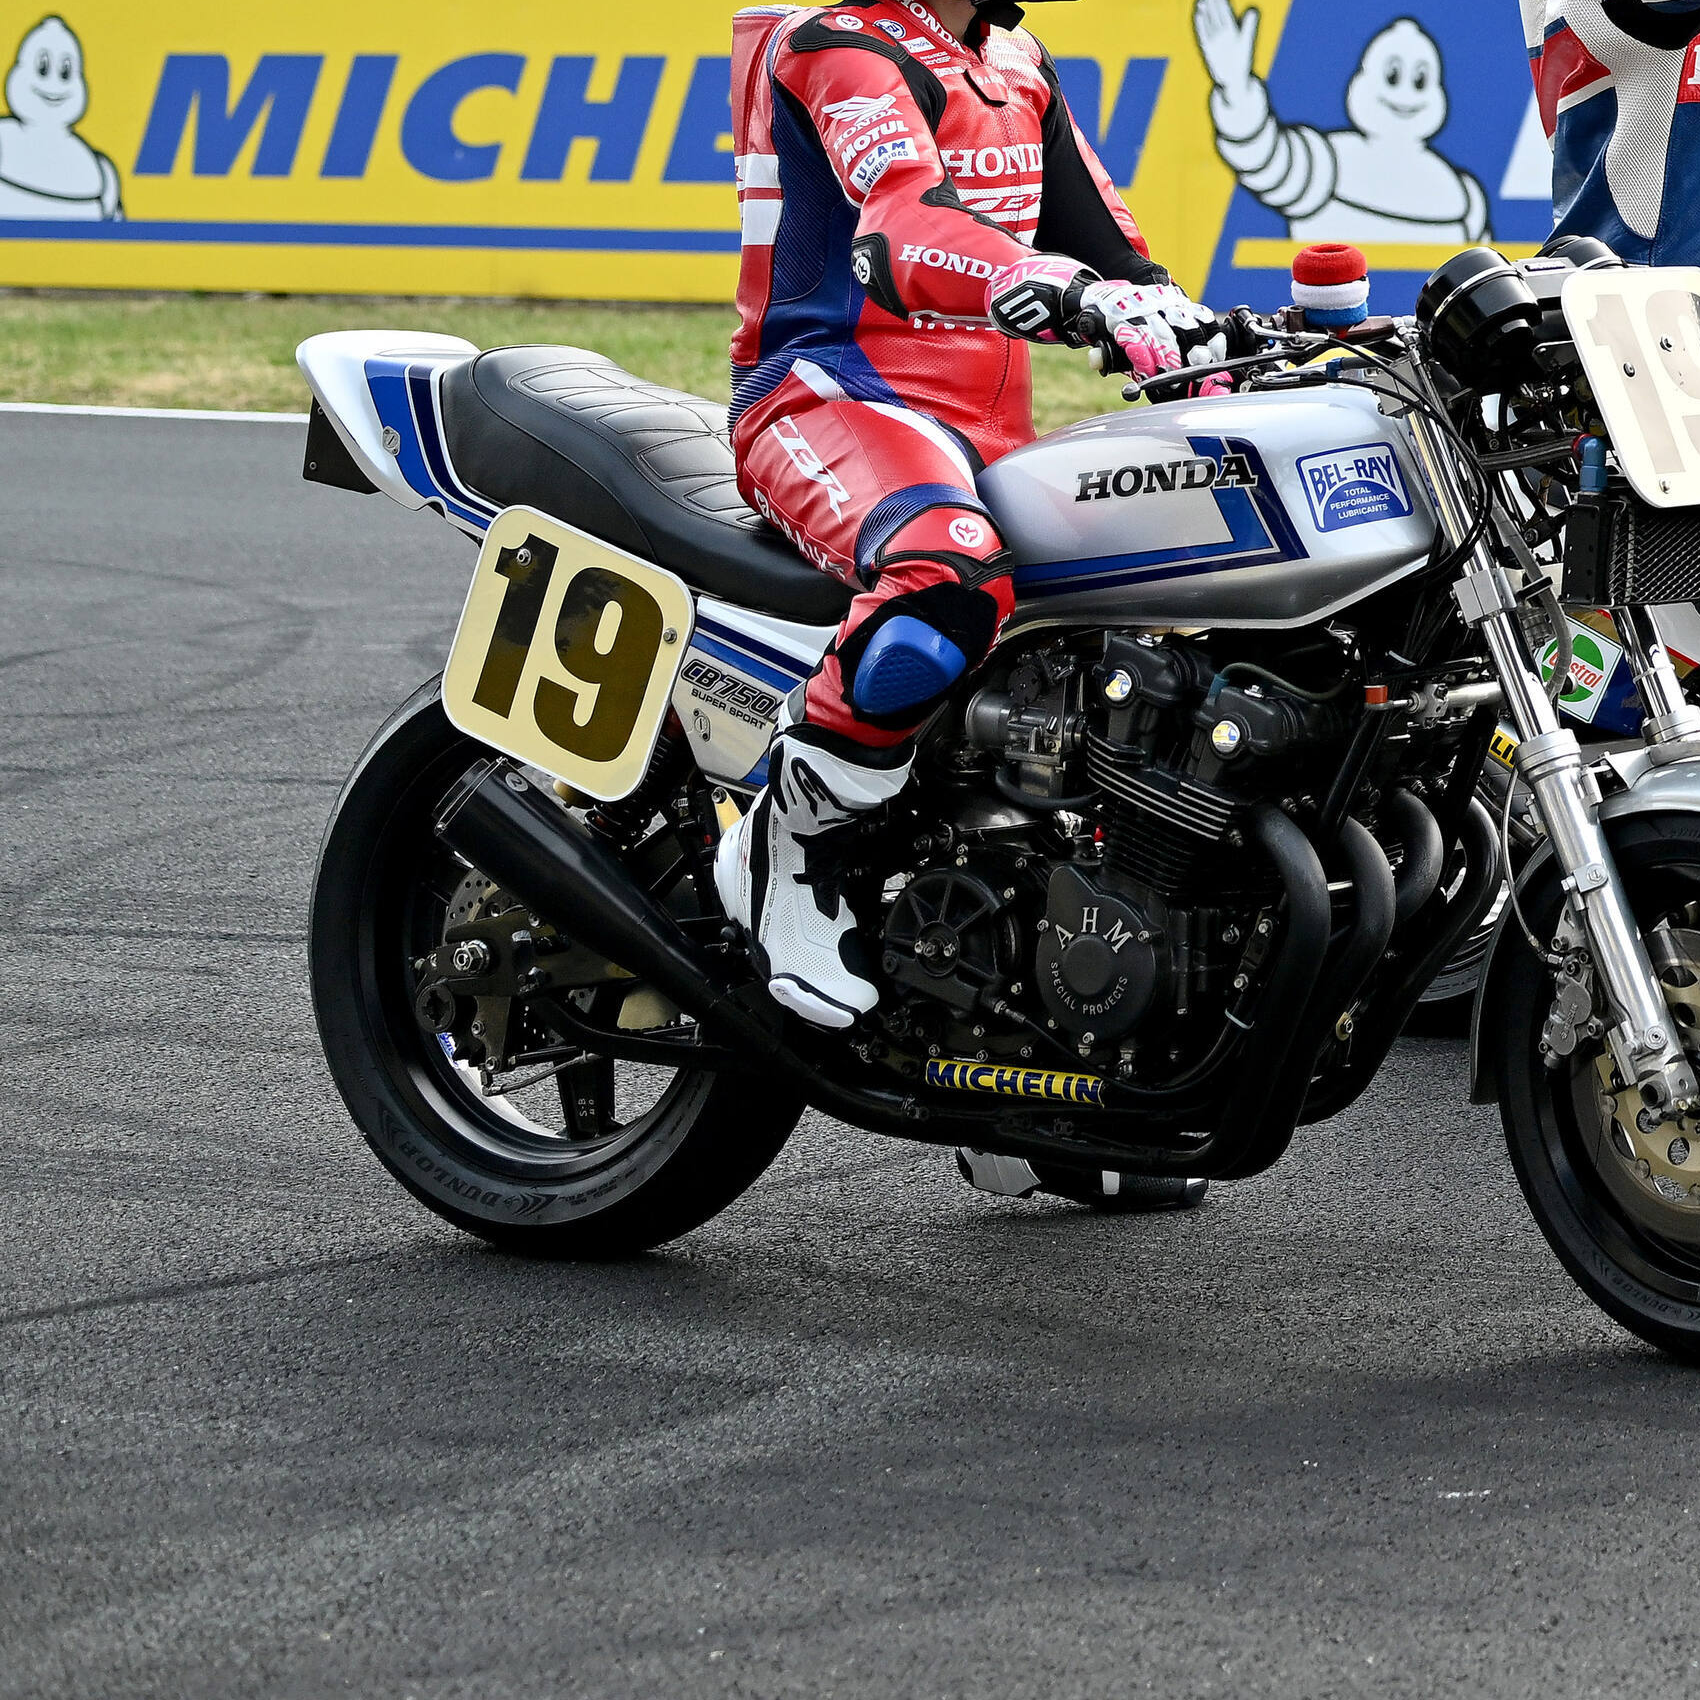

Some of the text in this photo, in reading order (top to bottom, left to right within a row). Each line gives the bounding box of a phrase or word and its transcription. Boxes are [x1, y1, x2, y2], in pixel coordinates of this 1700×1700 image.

[832, 106, 904, 151] HONDA
[840, 119, 910, 169] MOTUL
[856, 139, 907, 180] UCAM
[942, 142, 1044, 178] HOND
[1075, 452, 1259, 503] HONDA
[1307, 454, 1398, 508] BEL-RAY
[1343, 486, 1372, 498] TOTAL
[1329, 492, 1391, 511] PERFORMANCE
[1337, 503, 1389, 520] LUBRICANTS
[470, 532, 665, 763] 19
[690, 687, 767, 731] SUPER SPORT
[1055, 906, 1133, 954] AHM
[1050, 959, 1129, 1017] SPECIAL PROJECTS
[927, 1060, 1101, 1102] MICHELIN
